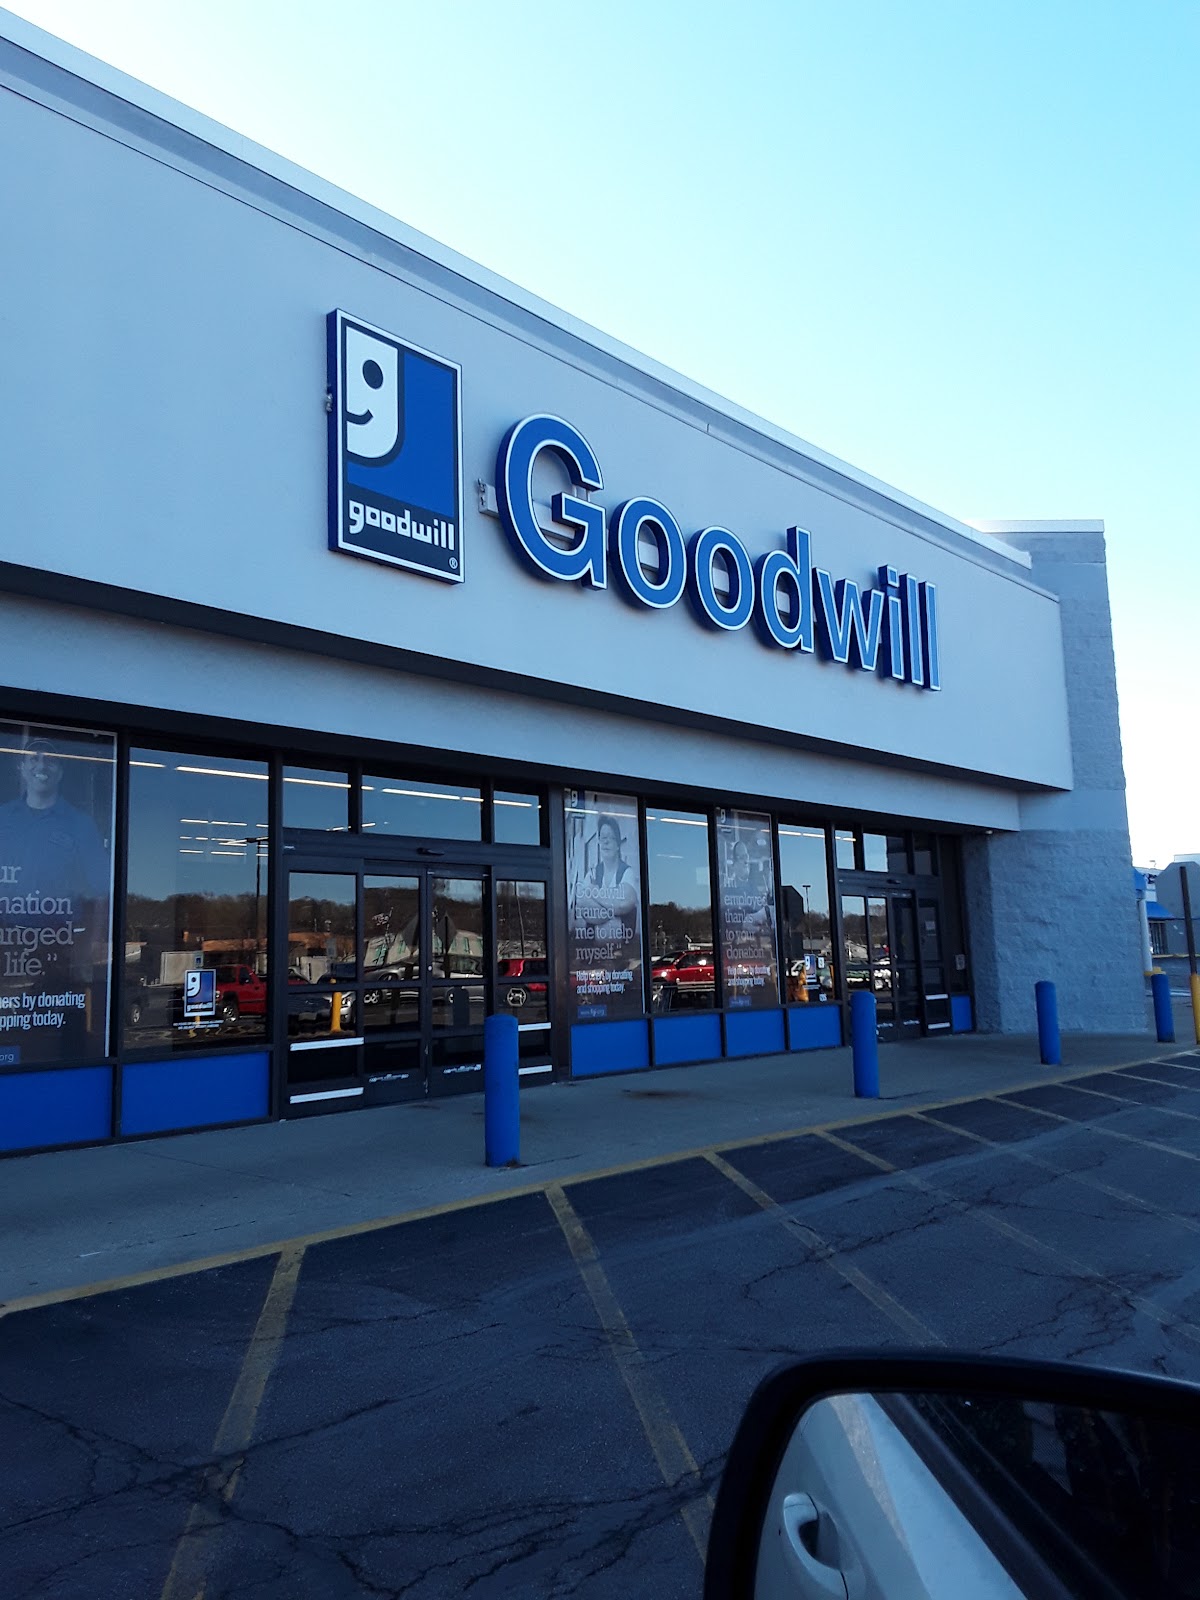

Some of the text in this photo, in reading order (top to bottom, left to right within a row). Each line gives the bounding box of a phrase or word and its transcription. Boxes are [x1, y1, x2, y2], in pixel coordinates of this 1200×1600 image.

[348, 499, 455, 551] goodwill
[496, 413, 941, 691] Goodwill
[0, 889, 74, 915] nation
[575, 903, 615, 919] trained
[575, 922, 634, 944] me to help
[22, 992, 36, 1011] by
[38, 990, 86, 1009] donating
[33, 1010, 66, 1028] today.
